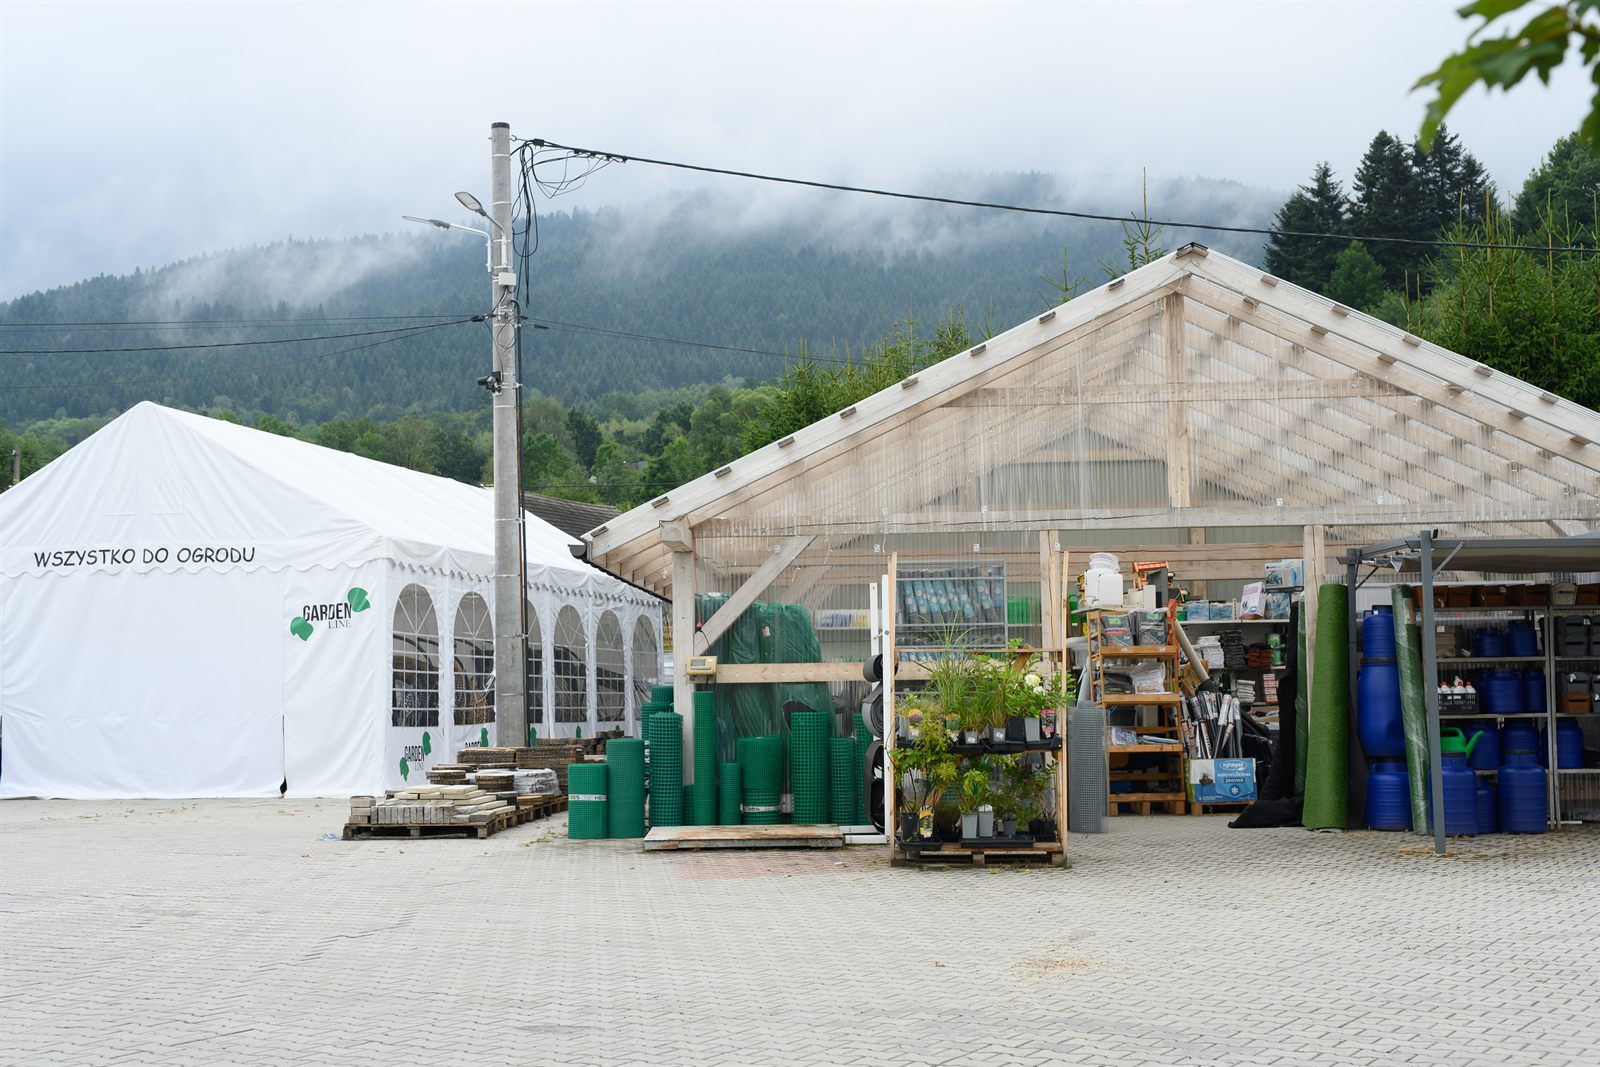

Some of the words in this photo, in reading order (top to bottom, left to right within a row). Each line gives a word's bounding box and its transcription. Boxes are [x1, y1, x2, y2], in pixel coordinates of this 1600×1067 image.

[34, 548, 136, 567] WSZYSTKO
[142, 547, 169, 563] DO
[176, 546, 255, 563] OGRODU
[303, 602, 352, 622] GARDEN
[328, 619, 352, 629] LINE
